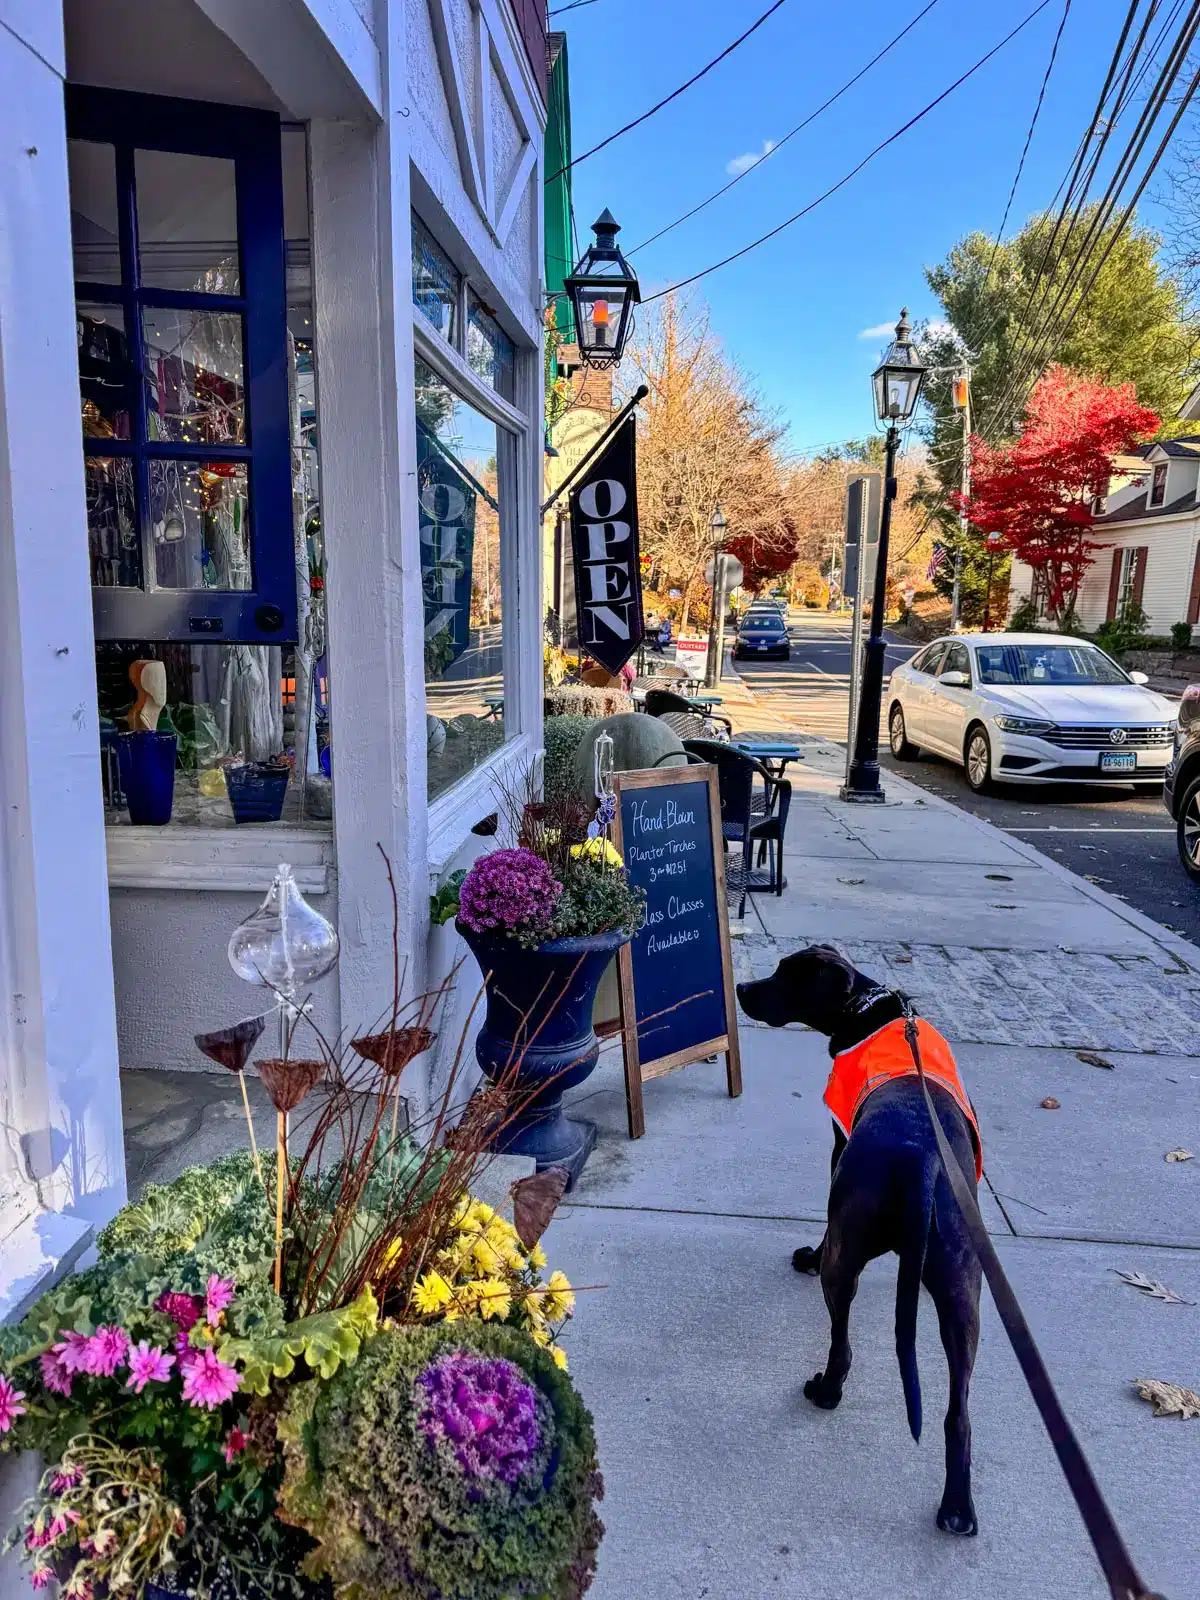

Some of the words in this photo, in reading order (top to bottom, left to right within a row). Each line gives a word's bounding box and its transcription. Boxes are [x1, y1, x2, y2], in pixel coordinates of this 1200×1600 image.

[579, 479, 633, 644] OPEN
[629, 845, 664, 866] Planter
[665, 840, 696, 854] Torches
[649, 867, 657, 882] 3
[668, 896, 704, 919] Classes
[647, 930, 693, 956] Available
